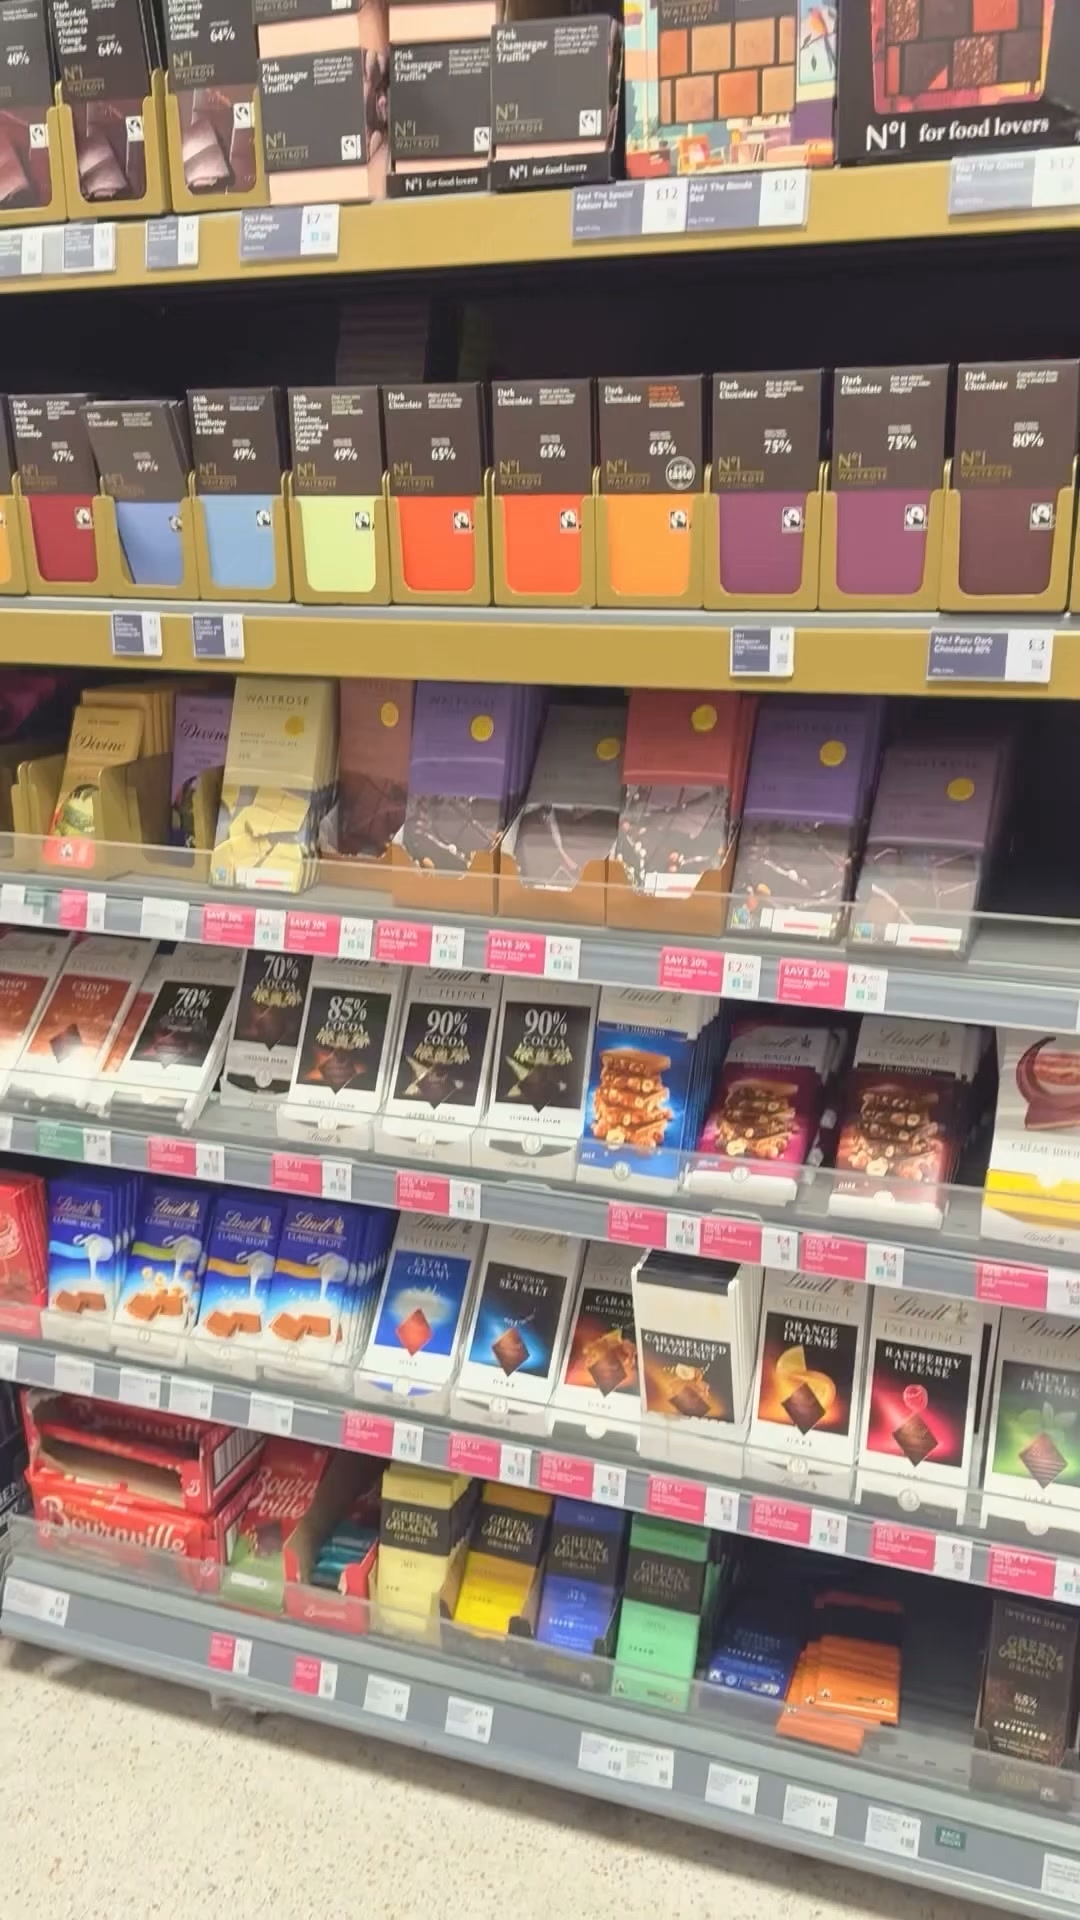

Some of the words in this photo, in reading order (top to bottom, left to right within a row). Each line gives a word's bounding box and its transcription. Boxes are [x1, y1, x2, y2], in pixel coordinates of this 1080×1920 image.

[54, 8, 86, 20] Chocolate
[663, 4, 719, 18] WAITROSE
[56, 19, 73, 29] filled
[72, 17, 88, 28] with
[210, 26, 235, 43] 64%
[497, 29, 517, 42] Pink
[97, 41, 122, 57] 64%
[497, 38, 548, 52] Champagne
[7, 52, 30, 66] 40%
[394, 51, 413, 62] Pink
[497, 51, 531, 64] Truffles
[174, 66, 215, 80] WAITROSE
[262, 63, 280, 73] Pink
[394, 60, 443, 73] Champagne
[262, 71, 308, 84] Champagne
[395, 70, 427, 82] Truffles
[262, 82, 294, 94] Truffles
[496, 121, 543, 134] WAITROSE
[919, 123, 946, 143] for
[948, 119, 990, 140] food
[994, 114, 1049, 137] lovers
[395, 137, 439, 150] WAITROSE
[266, 148, 309, 160] WAITROSE
[532, 165, 545, 176] for
[545, 164, 564, 175] food
[564, 162, 588, 174] lovers
[426, 179, 437, 188] for
[437, 178, 455, 188] food
[456, 176, 478, 186] lovers
[710, 181, 725, 192] The
[773, 178, 797, 192] £12
[656, 188, 679, 201] £12
[841, 375, 862, 387] Dark
[965, 371, 987, 383] Dark
[498, 387, 515, 398] Dark
[605, 385, 624, 395] Dark
[720, 381, 739, 391] Dark
[841, 384, 882, 396] Chocolate
[964, 379, 1008, 392] Chocolate
[388, 391, 405, 401] Dark
[498, 396, 533, 407] Chocolate
[605, 393, 642, 404] Chocolate
[720, 389, 759, 400] Chocolate
[193, 403, 225, 413] Chocolate
[388, 400, 423, 410] Chocolate
[764, 439, 792, 455] 75%
[887, 435, 917, 451] 75%
[1012, 432, 1044, 448] 80%
[334, 447, 358, 461] 49%
[431, 447, 456, 462] 65%
[540, 444, 566, 460] 65%
[649, 441, 677, 456] 65%
[52, 450, 75, 463] 47%
[607, 474, 650, 487] WAITROSE
[719, 471, 765, 485] WAITROSE
[839, 469, 888, 482] WAITROSE
[961, 467, 1013, 480] WAITROSE
[298, 478, 337, 489] WAITROSE
[394, 478, 435, 490] WAITROSE
[500, 476, 542, 487] WAITROSE
[954, 635, 973, 646] Peru
[974, 635, 993, 646] Dark
[934, 645, 973, 655] Chocolate
[247, 695, 309, 706] WAITROSE
[75, 733, 126, 751] Divine
[207, 911, 227, 922] SAVE
[290, 918, 309, 930] SAVE
[380, 927, 400, 938] SAVE
[491, 938, 512, 950] SAVE
[263, 955, 299, 980] 70%
[665, 955, 688, 966] SAVE
[784, 966, 809, 978] SAVE
[72, 981, 112, 994] CRISPY
[260, 978, 296, 990] COCOA
[176, 988, 212, 1009] 70%
[169, 1007, 204, 1019] COCOA
[327, 996, 367, 1021] 85%
[325, 1020, 364, 1032] COCOA
[427, 1009, 468, 1035] 90%
[524, 1008, 567, 1036] 90%
[424, 1034, 464, 1047] COCOA
[522, 1034, 565, 1048] COCOA
[880, 1027, 934, 1048] Lindt
[57, 1195, 90, 1213] Lindt
[154, 1196, 189, 1214] Lindt
[221, 1210, 260, 1229] Lindt
[289, 1211, 332, 1232] Lindt
[409, 1217, 456, 1234] Lindt
[244, 1235, 269, 1248] RECIPE
[287, 1231, 315, 1245] CLASSIC
[317, 1235, 342, 1249] RECIPE
[414, 1256, 449, 1271] EXTRA
[407, 1265, 450, 1281] CREAMY
[499, 1278, 519, 1291] SEA
[521, 1282, 549, 1297] SALT
[785, 1272, 838, 1293] Lindt
[890, 1295, 946, 1321] Lindt
[784, 1319, 839, 1340] ORANGE
[884, 1321, 966, 1346] EXCELLENCE
[1022, 1315, 1080, 1340] Lindt
[644, 1333, 728, 1356] CARAMELISED
[783, 1331, 838, 1350] INTENSE
[655, 1344, 717, 1363] HAZELNUT
[884, 1346, 962, 1370] RASPBERRY
[894, 1360, 951, 1379] INTENSE
[1033, 1370, 1067, 1385] MINT
[1021, 1378, 1079, 1400] INTENSE
[259, 1495, 306, 1519] ville
[391, 1509, 432, 1524] GREEN
[488, 1514, 529, 1531] GREEN
[40, 1496, 187, 1553] Bournville
[393, 1532, 428, 1545] ORGANIC
[561, 1535, 604, 1549] GREEN
[640, 1560, 686, 1579] GREEN
[1007, 1635, 1057, 1654] GREEN
